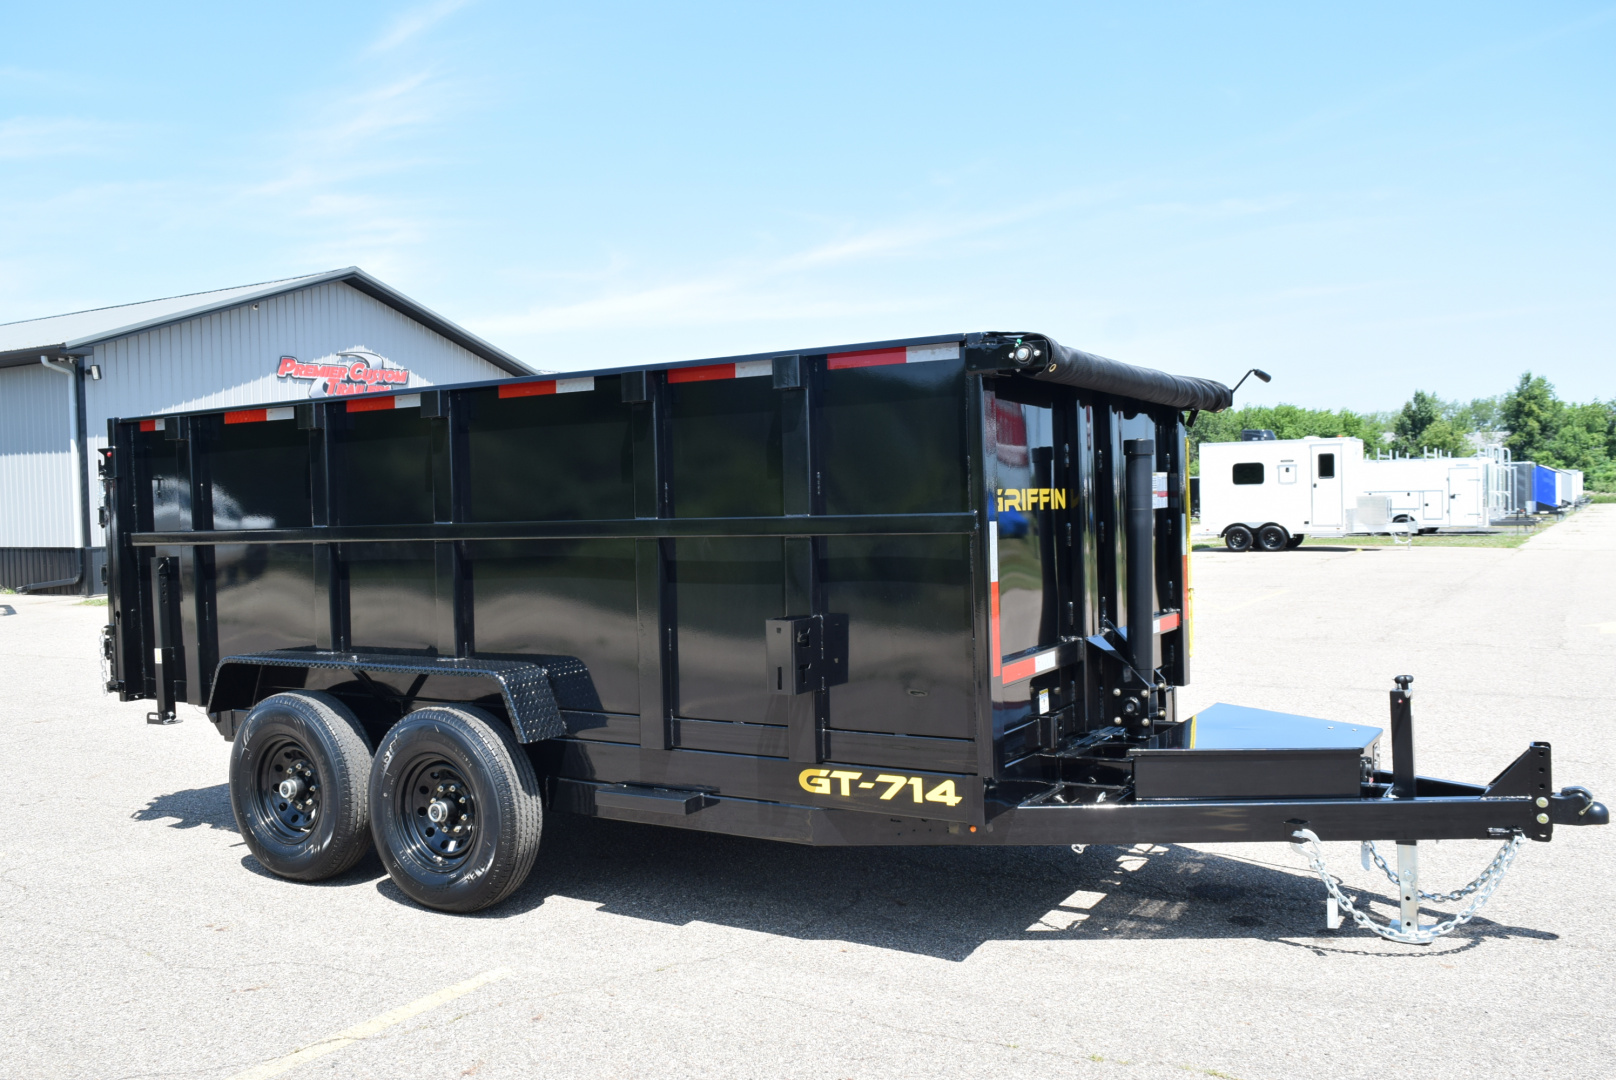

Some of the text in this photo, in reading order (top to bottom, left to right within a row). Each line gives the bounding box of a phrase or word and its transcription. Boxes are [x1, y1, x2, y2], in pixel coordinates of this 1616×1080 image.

[277, 357, 408, 384] PREMIER CUSTOM
[798, 768, 963, 807] GT-714
